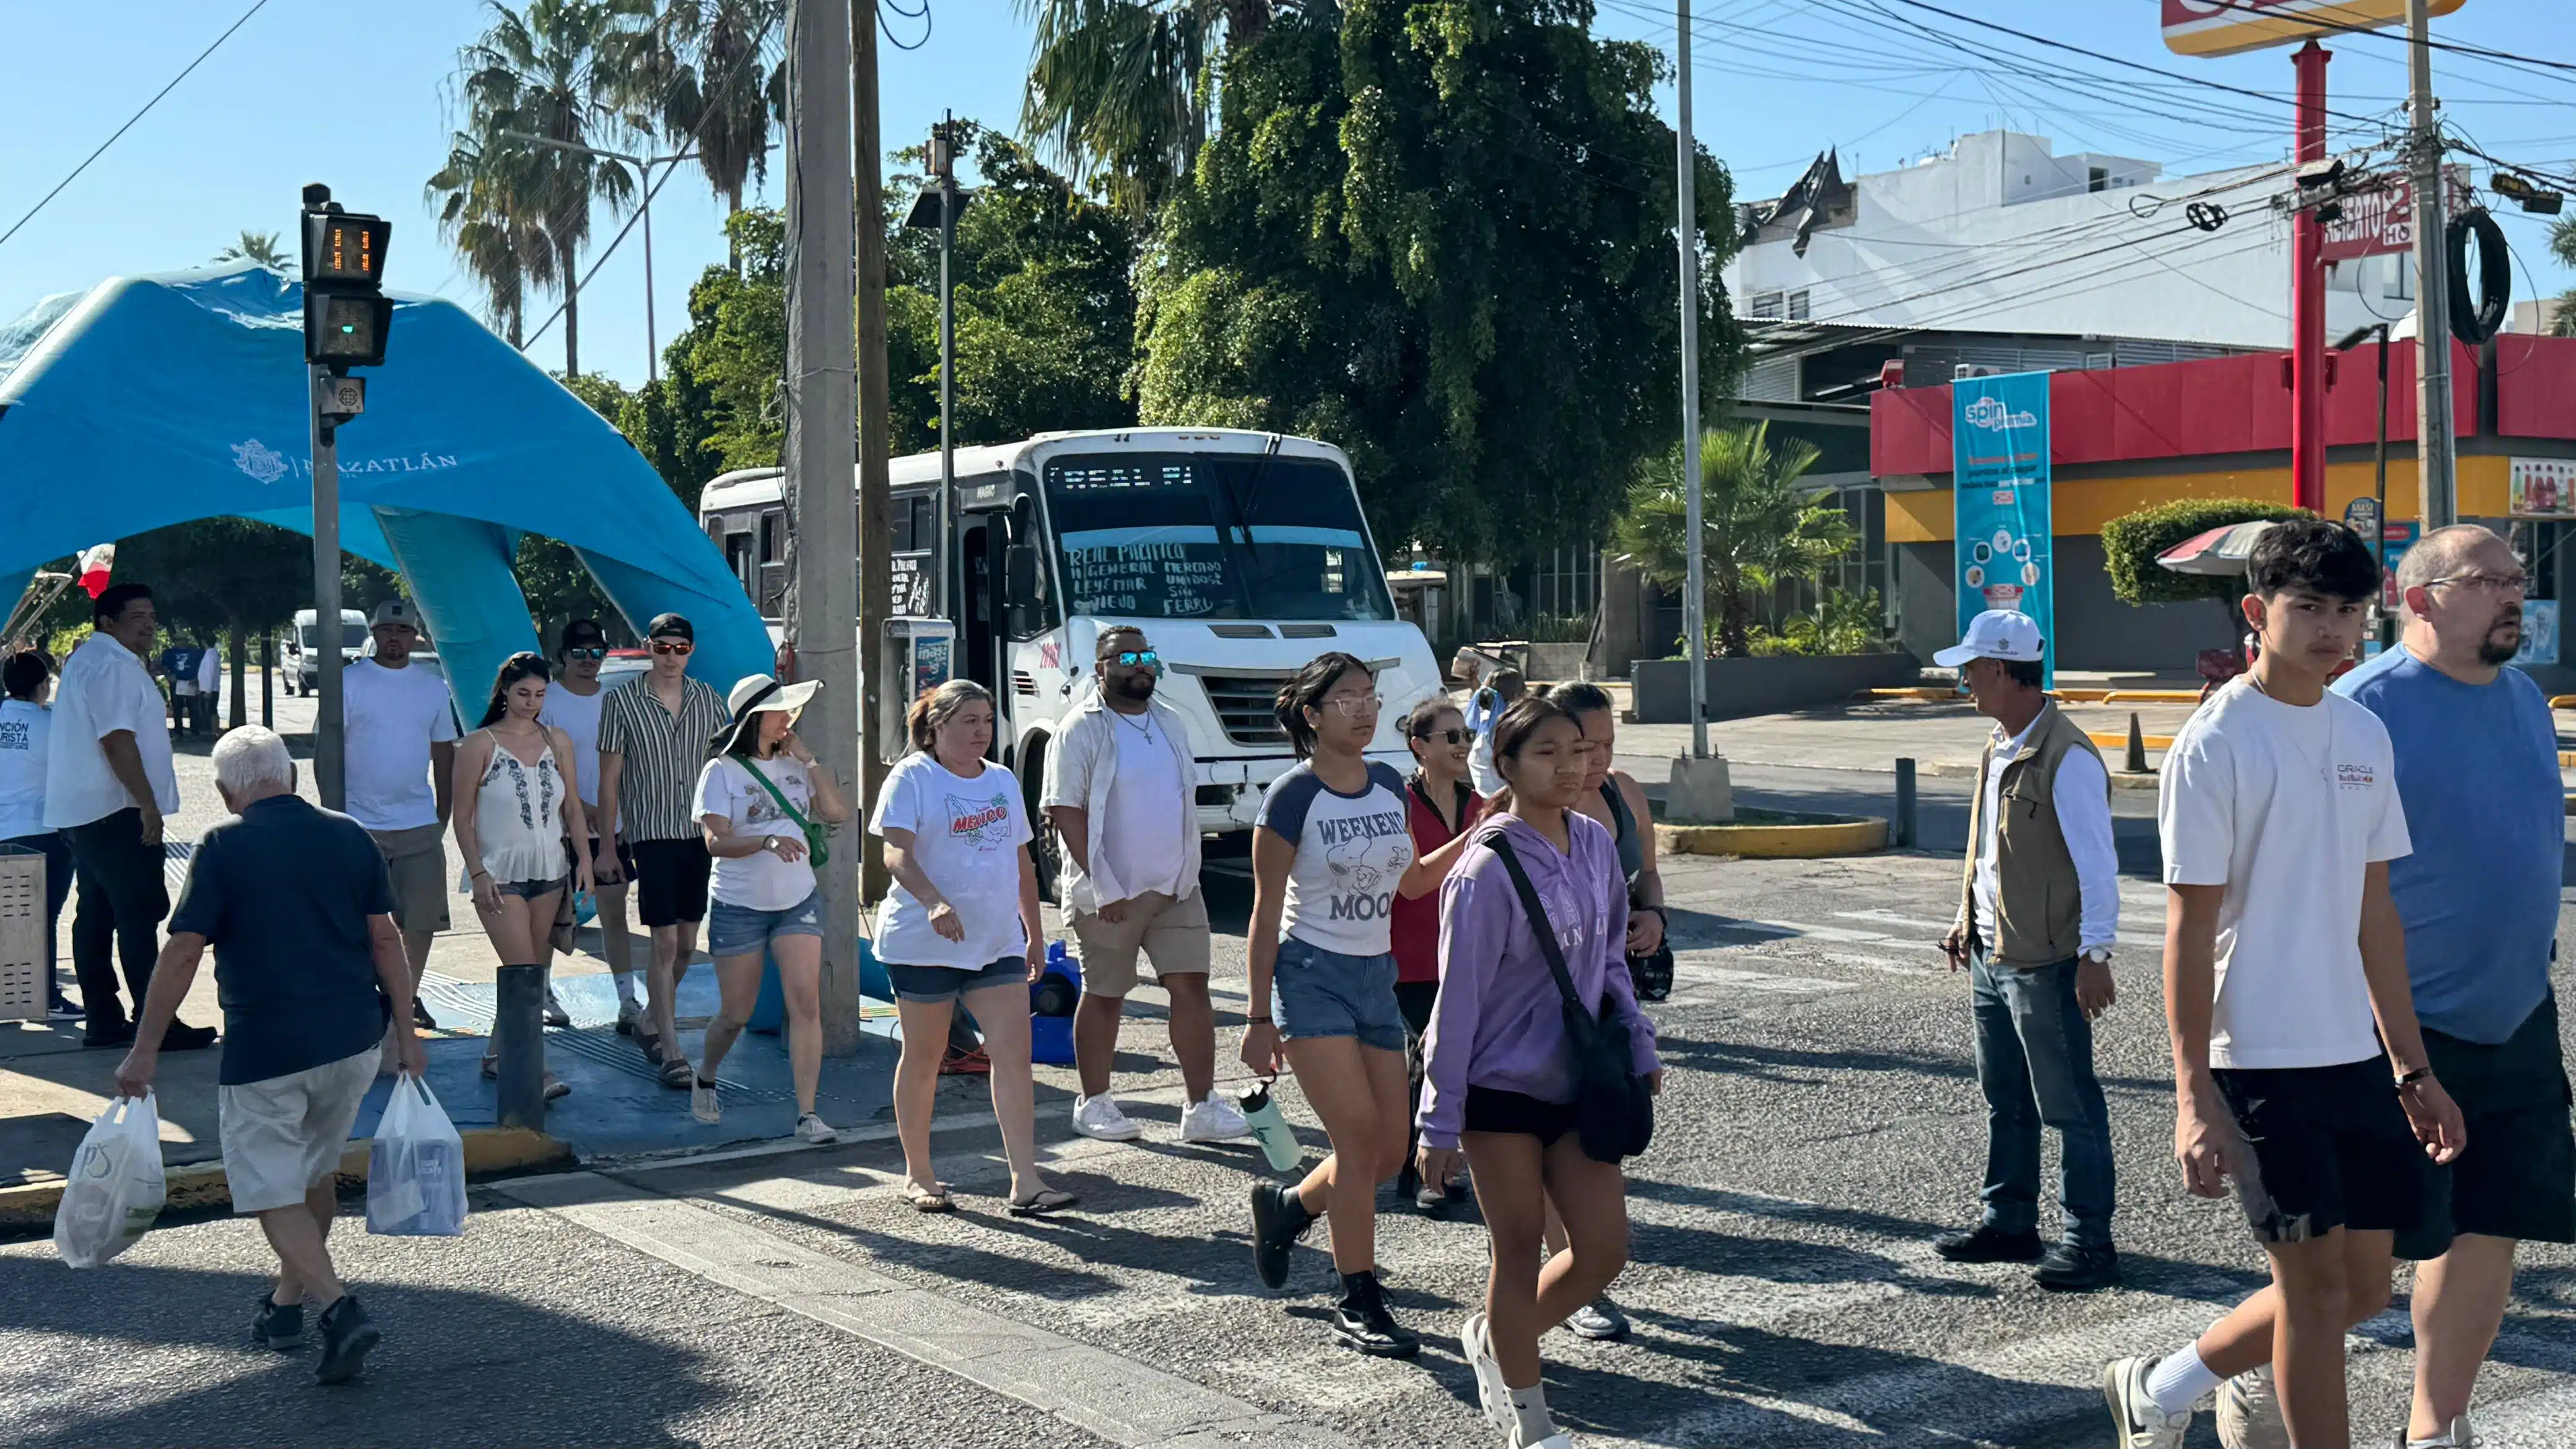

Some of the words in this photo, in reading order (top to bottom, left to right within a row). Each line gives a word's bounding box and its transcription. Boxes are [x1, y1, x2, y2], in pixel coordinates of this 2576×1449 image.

[334, 228, 369, 271] 11
[303, 452, 459, 474] ZATLÁN
[953, 806, 1007, 833] MEXICO
[1329, 890, 1395, 921] MOO
